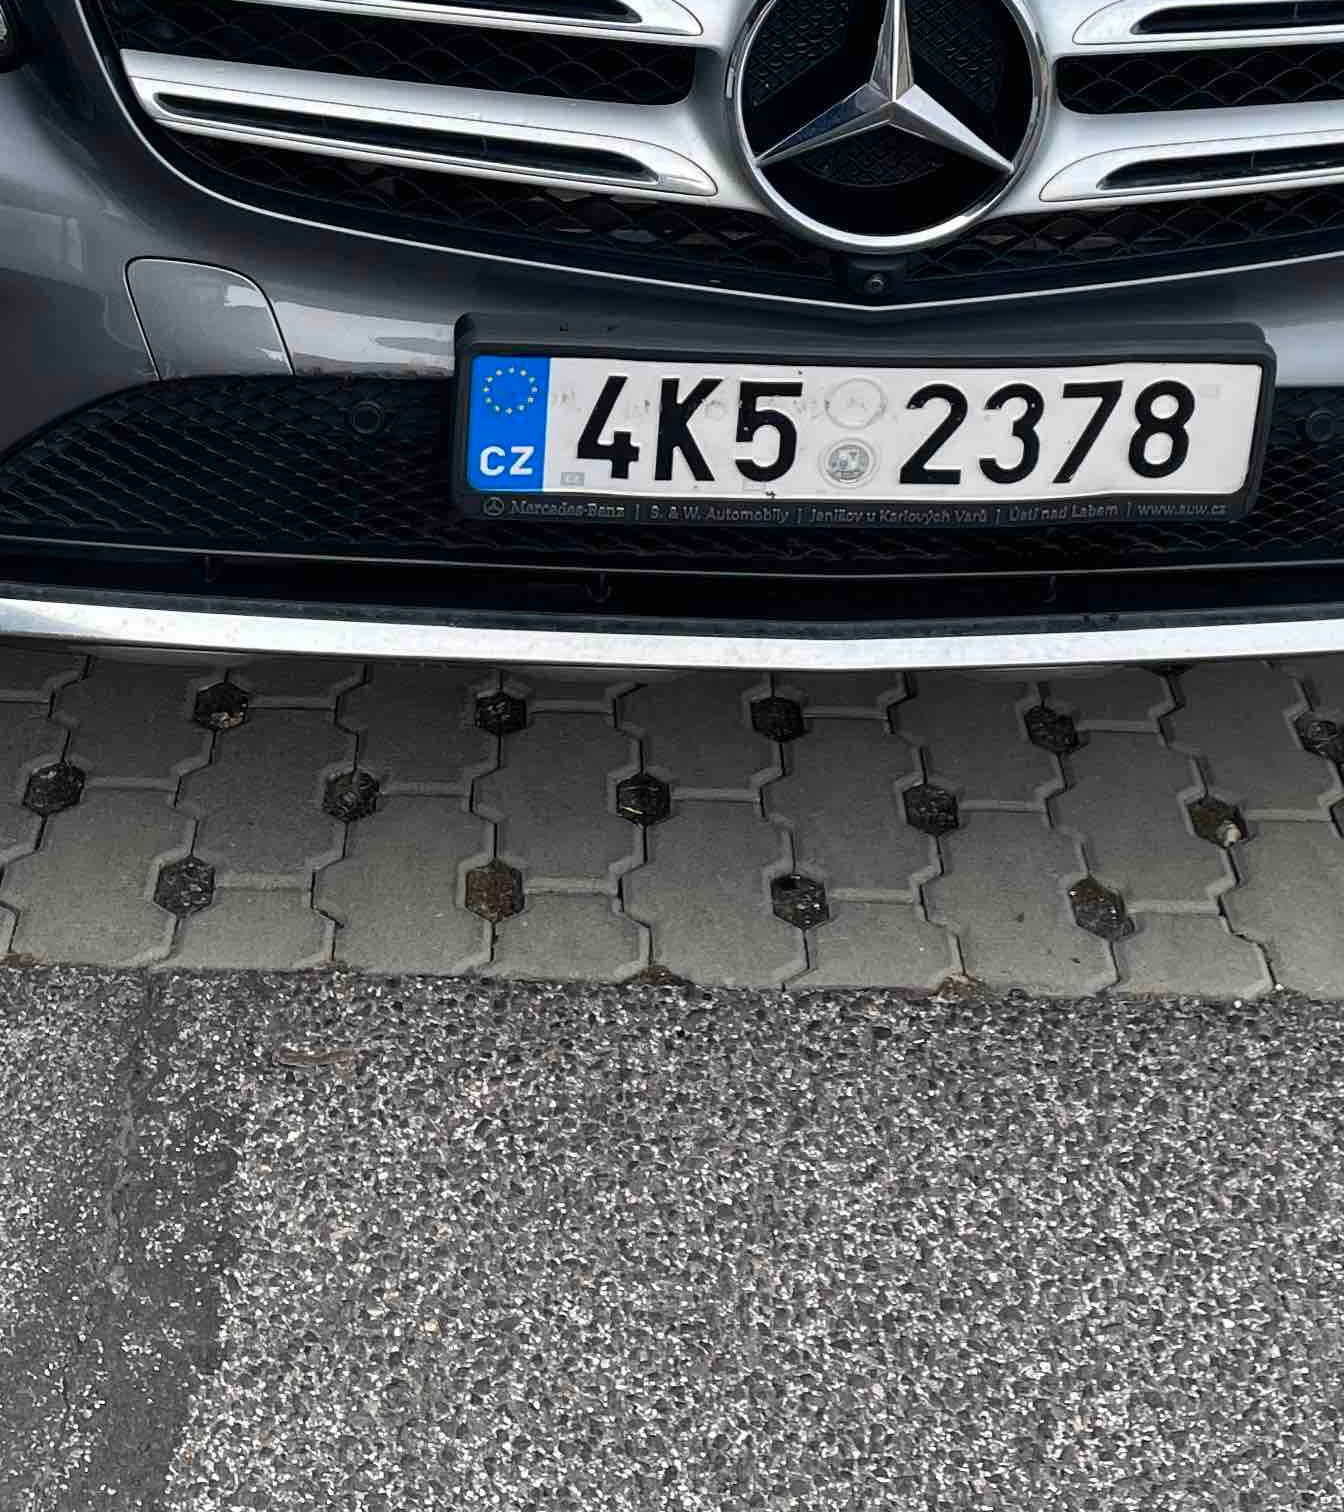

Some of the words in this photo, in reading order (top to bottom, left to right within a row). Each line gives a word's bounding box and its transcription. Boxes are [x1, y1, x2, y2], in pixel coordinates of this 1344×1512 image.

[480, 445, 534, 476] CZ
[576, 375, 805, 483] 4K5
[899, 379, 1197, 485] 2378
[510, 500, 626, 519] Mercedes-Benz
[706, 505, 790, 525] Automobily
